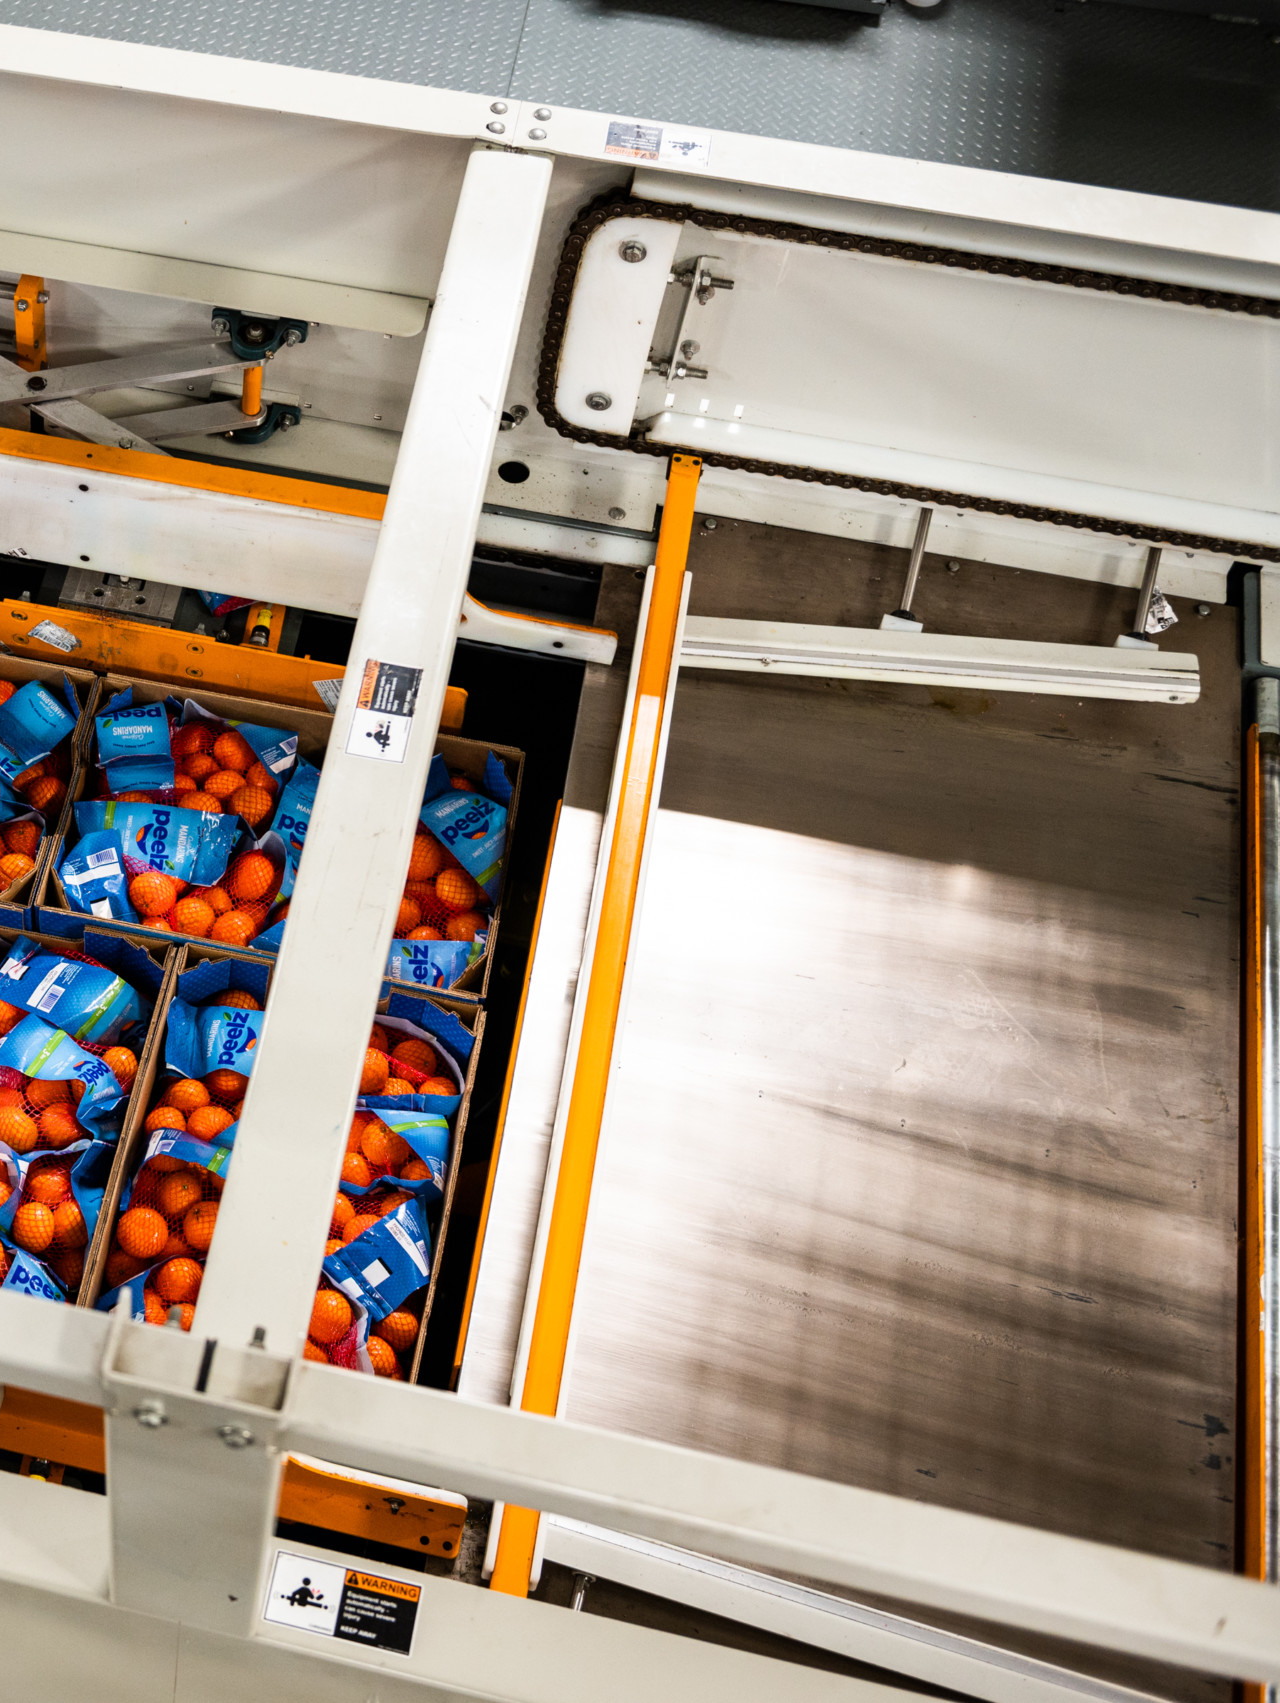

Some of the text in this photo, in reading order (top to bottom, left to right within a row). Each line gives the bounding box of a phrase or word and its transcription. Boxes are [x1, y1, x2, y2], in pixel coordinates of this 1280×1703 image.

[37, 690, 68, 719] MANDARINS
[112, 725, 153, 736] MANDARINS
[434, 797, 470, 819] MANDARINS
[440, 801, 496, 845] peelz
[148, 809, 171, 871] peelz
[175, 824, 189, 864] MANDARINS
[392, 956, 403, 979] ARINS
[408, 945, 429, 985] elz
[207, 1019, 221, 1058] MANDARINS
[217, 1011, 250, 1066] peelz
[43, 1048, 50, 1056] 3
[78, 1058, 111, 1085] peelz
[10, 1264, 54, 1300] pee
[347, 1590, 397, 1608] Equipment starts
[361, 1576, 417, 1598] WARNING
[343, 1612, 361, 1622] injury
[357, 1608, 375, 1617] cause
[375, 1613, 396, 1622] severe
[340, 1625, 377, 1639] KEEP AWAY
